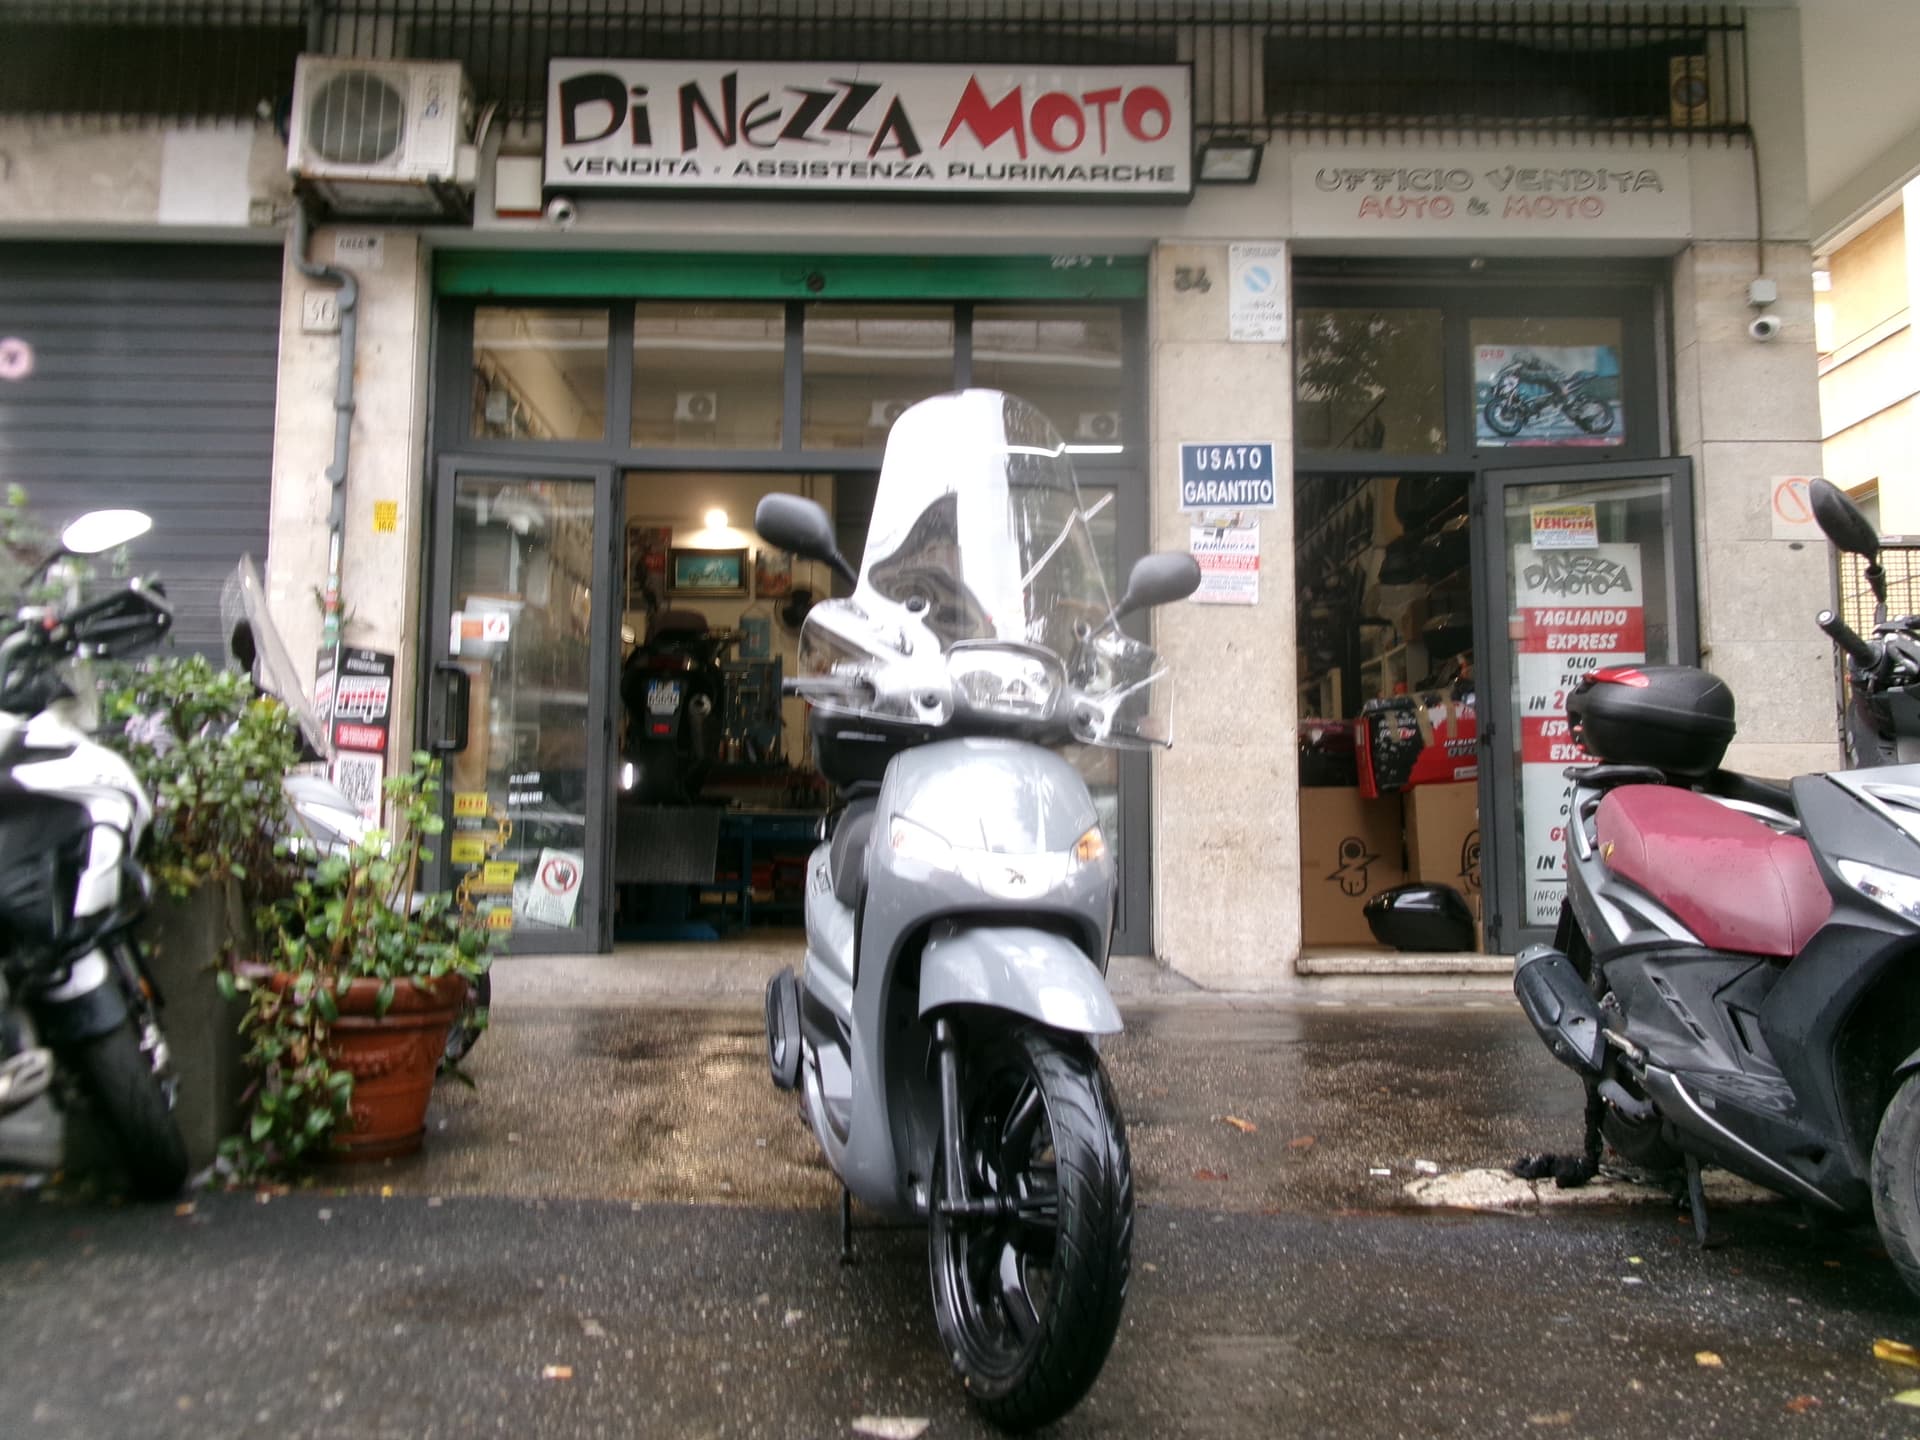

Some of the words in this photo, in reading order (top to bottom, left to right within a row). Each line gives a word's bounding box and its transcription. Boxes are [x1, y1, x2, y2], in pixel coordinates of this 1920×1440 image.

[940, 73, 1172, 160] MOTO
[563, 157, 700, 175] VENDITA
[734, 161, 936, 180] ASSISTENZA
[947, 161, 1176, 182] PLURIMARCHE
[1315, 168, 1473, 192] UFFICIO
[1485, 165, 1665, 193] VENDITA
[1358, 195, 1456, 219] AUTO
[1502, 195, 1605, 219] MOTO
[1196, 447, 1262, 471] USATO
[1184, 480, 1272, 503] GARANTITO
[1534, 610, 1628, 626] TAGLIANDO
[1546, 634, 1618, 650] EXPRESS
[1567, 656, 1597, 669] OLIO
[1528, 695, 1546, 710] IN
[1552, 690, 1565, 710] 2
[1540, 720, 1568, 737] ISP
[1536, 856, 1555, 870] IN
